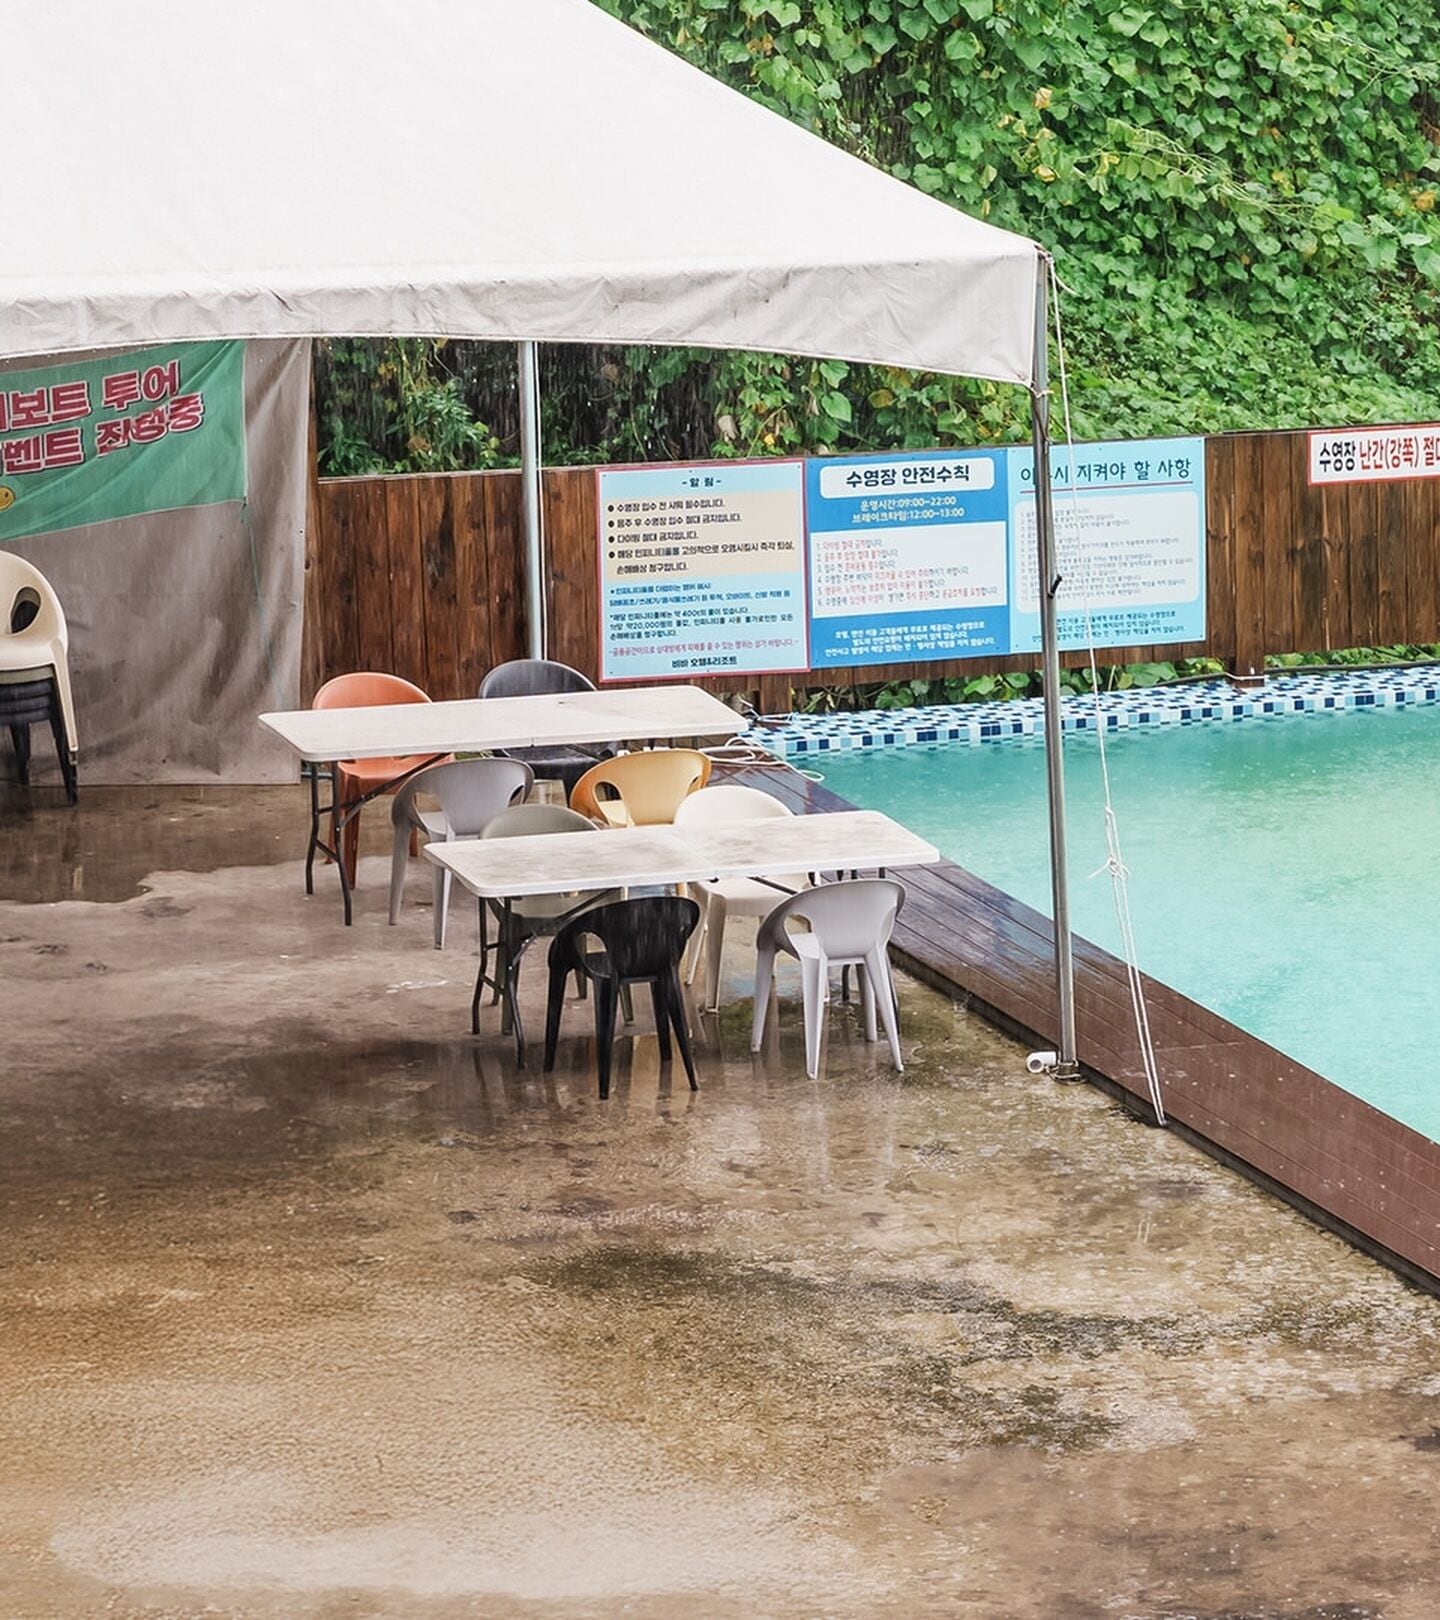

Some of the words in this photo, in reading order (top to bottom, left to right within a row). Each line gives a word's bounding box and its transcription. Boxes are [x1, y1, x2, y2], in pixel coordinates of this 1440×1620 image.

[0, 380, 92, 432] 보트
[102, 359, 180, 412] 투어
[0, 427, 84, 475] 벤트
[96, 392, 204, 457] 진행중
[1319, 440, 1356, 473] 수영장
[1360, 436, 1419, 470] 난간(강쪽)
[846, 468, 897, 488] 수영장
[902, 464, 970, 485] 안전수칙
[1020, 465, 1069, 486] 이시
[1077, 461, 1126, 482] 지켜야
[1134, 460, 1150, 480] 할
[1157, 458, 1191, 479] 사항
[617, 502, 640, 512] 수영장
[644, 517, 667, 526] 수영장
